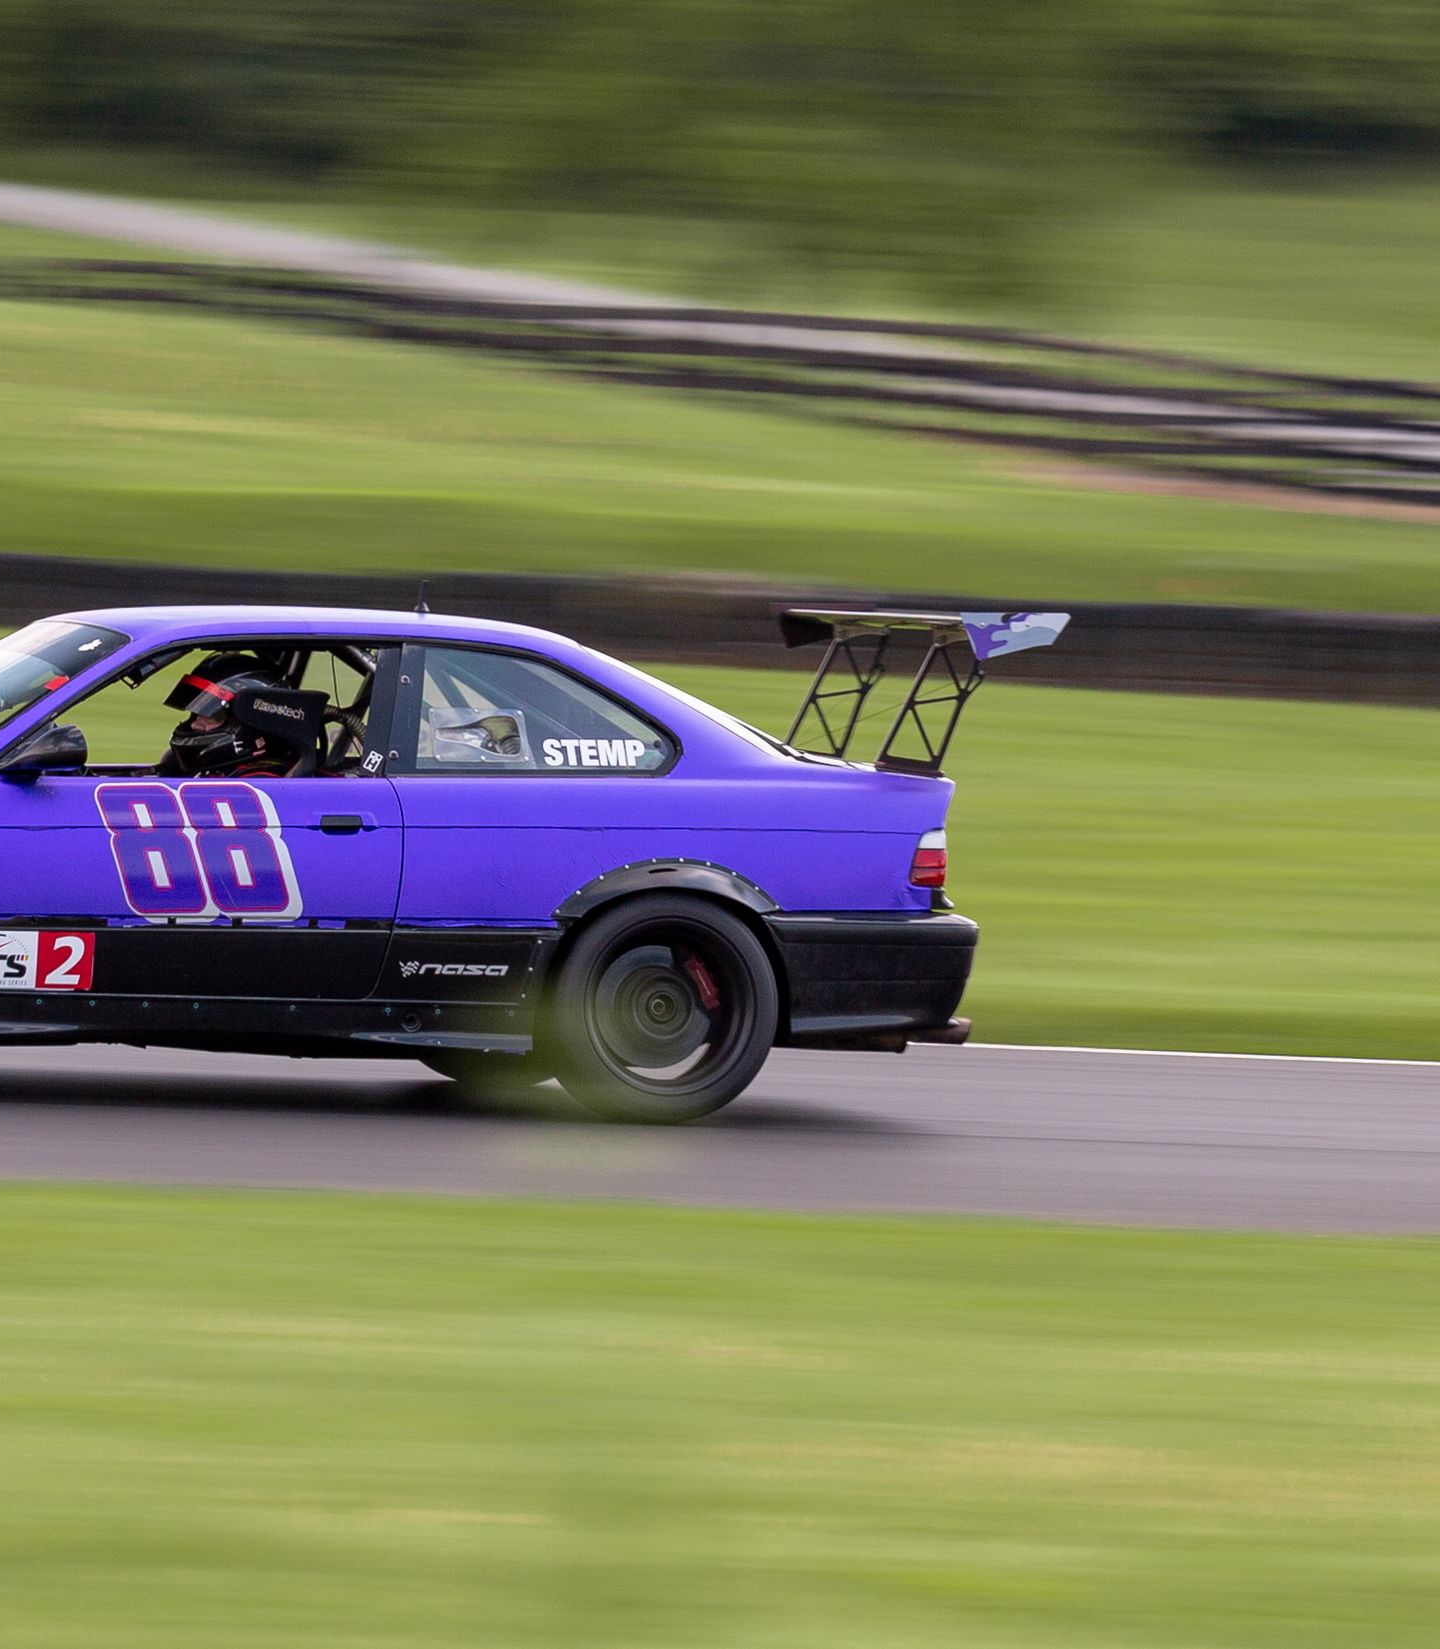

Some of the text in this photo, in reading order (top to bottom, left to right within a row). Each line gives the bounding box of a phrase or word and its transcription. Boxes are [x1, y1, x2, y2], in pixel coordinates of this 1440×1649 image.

[253, 698, 305, 720] Racetech
[542, 738, 646, 767] STEMP
[94, 781, 304, 924] 88
[44, 936, 85, 985] 2
[418, 964, 509, 976] nasa
